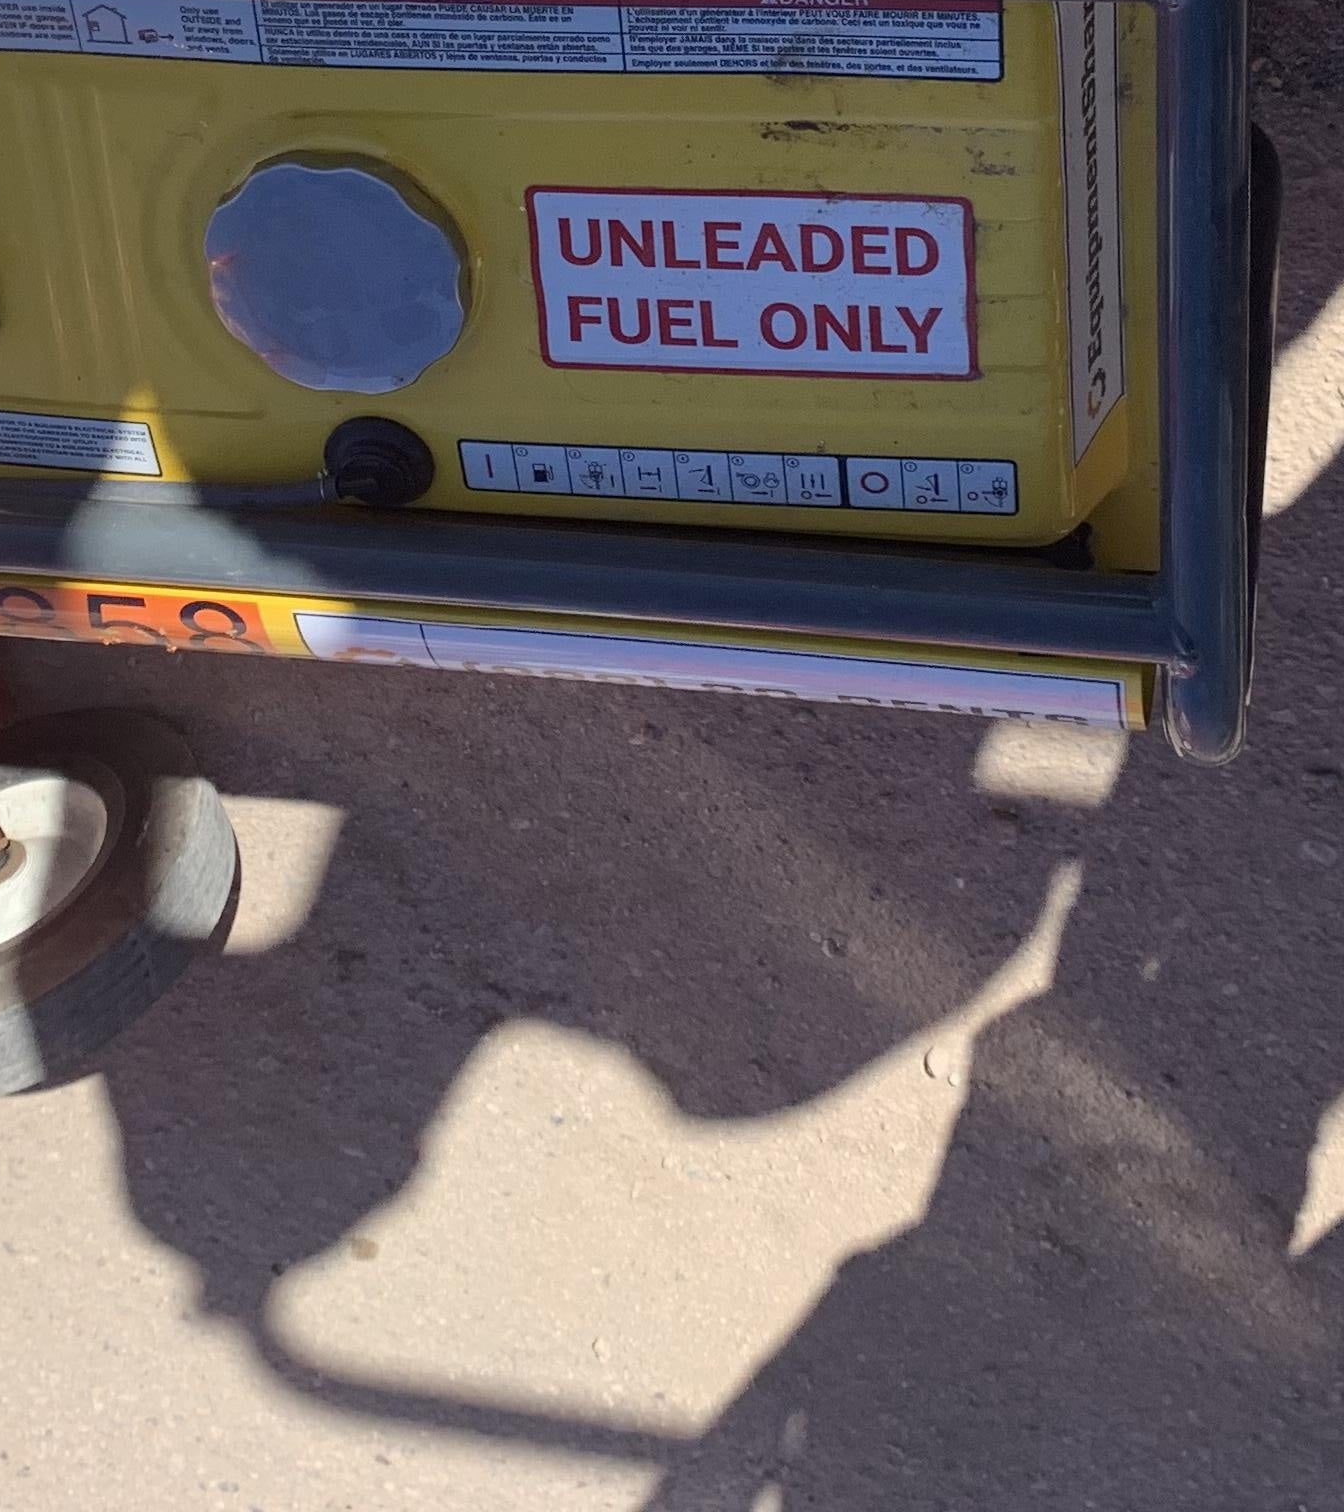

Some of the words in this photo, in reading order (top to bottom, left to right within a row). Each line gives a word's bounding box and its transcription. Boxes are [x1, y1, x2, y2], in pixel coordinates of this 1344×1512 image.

[1077, 1, 1108, 370] EquipmentShar
[558, 216, 941, 277] UNLEADED
[567, 294, 738, 348] FUEL
[758, 303, 944, 355] ONLY
